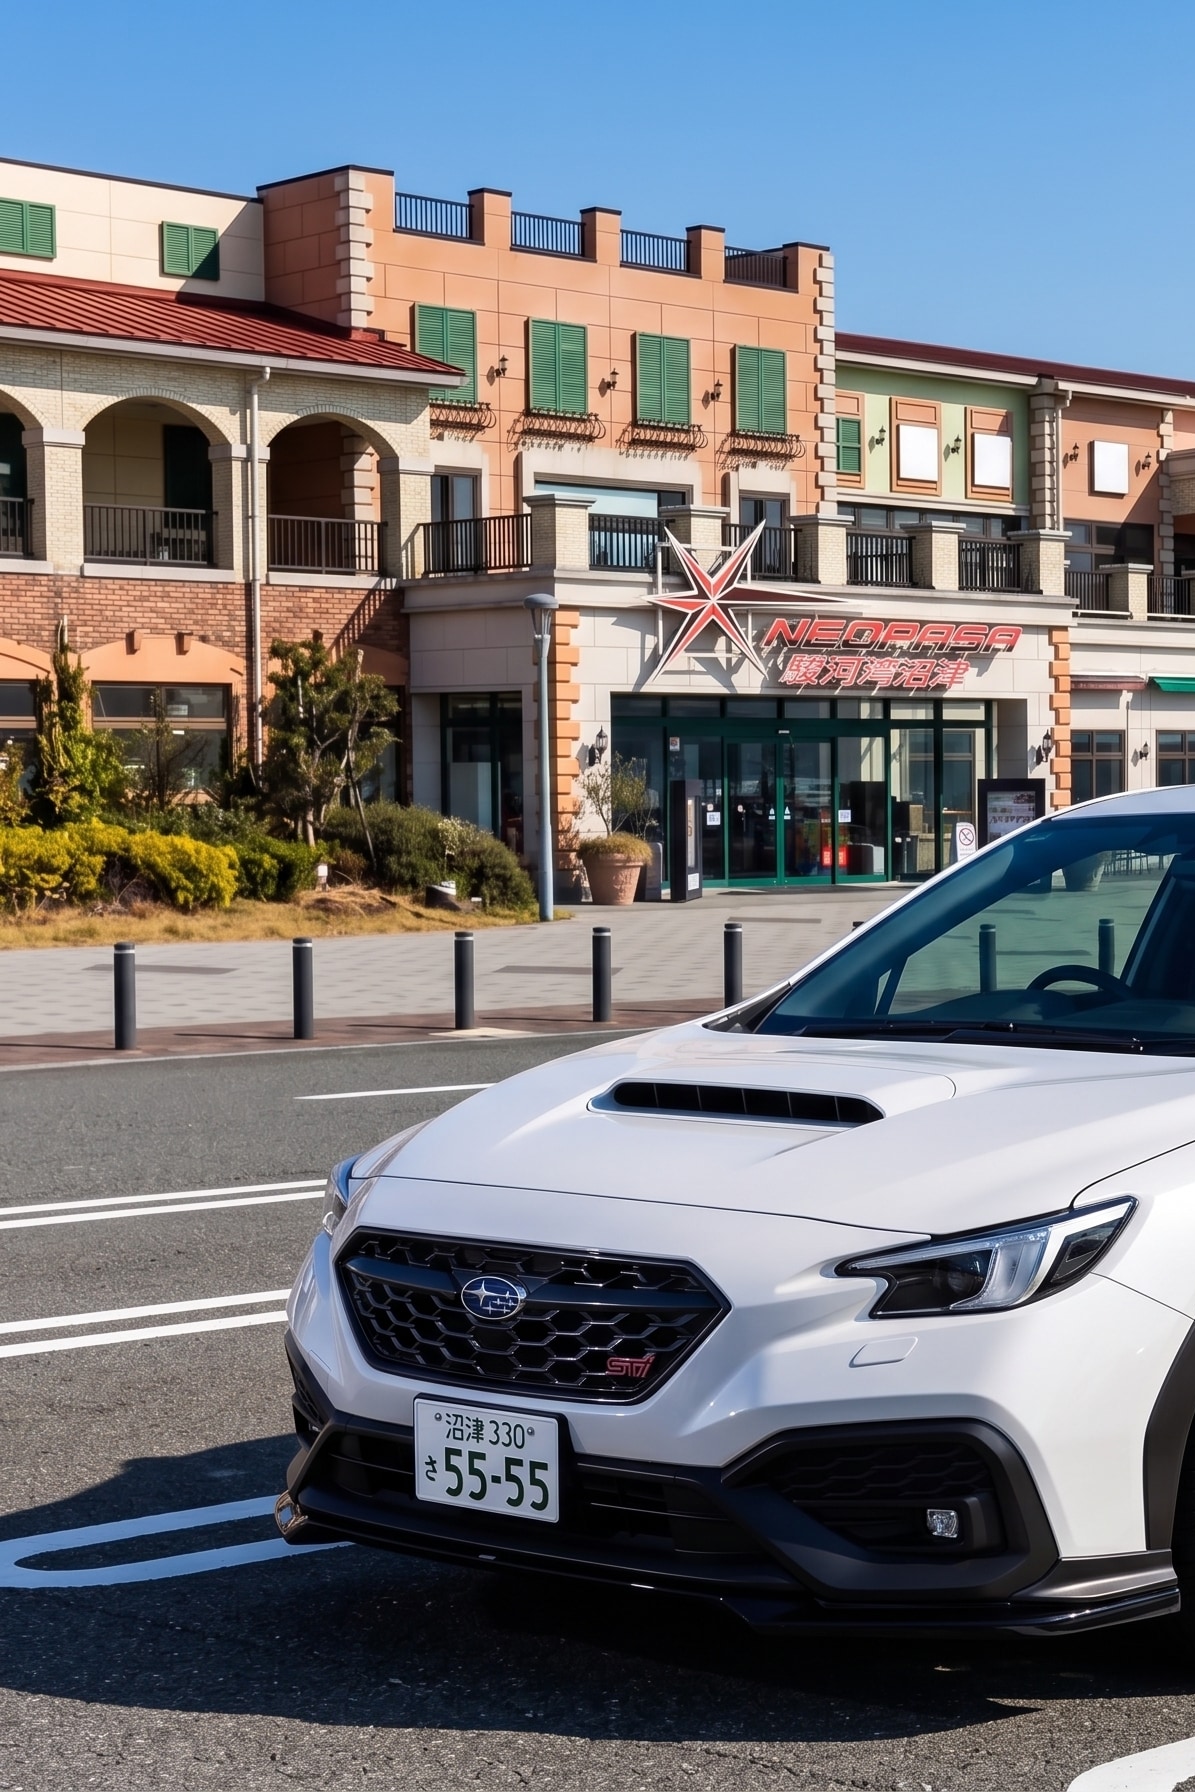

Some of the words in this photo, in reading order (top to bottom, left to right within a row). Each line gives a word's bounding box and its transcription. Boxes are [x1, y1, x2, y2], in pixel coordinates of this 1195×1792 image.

[761, 618, 1023, 653] NEOPASA
[779, 653, 970, 690] 駿河湾沼津
[445, 1412, 485, 1443] 沼津
[488, 1419, 525, 1449] 330
[424, 1455, 437, 1481] さ
[444, 1446, 549, 1511] 55-55
